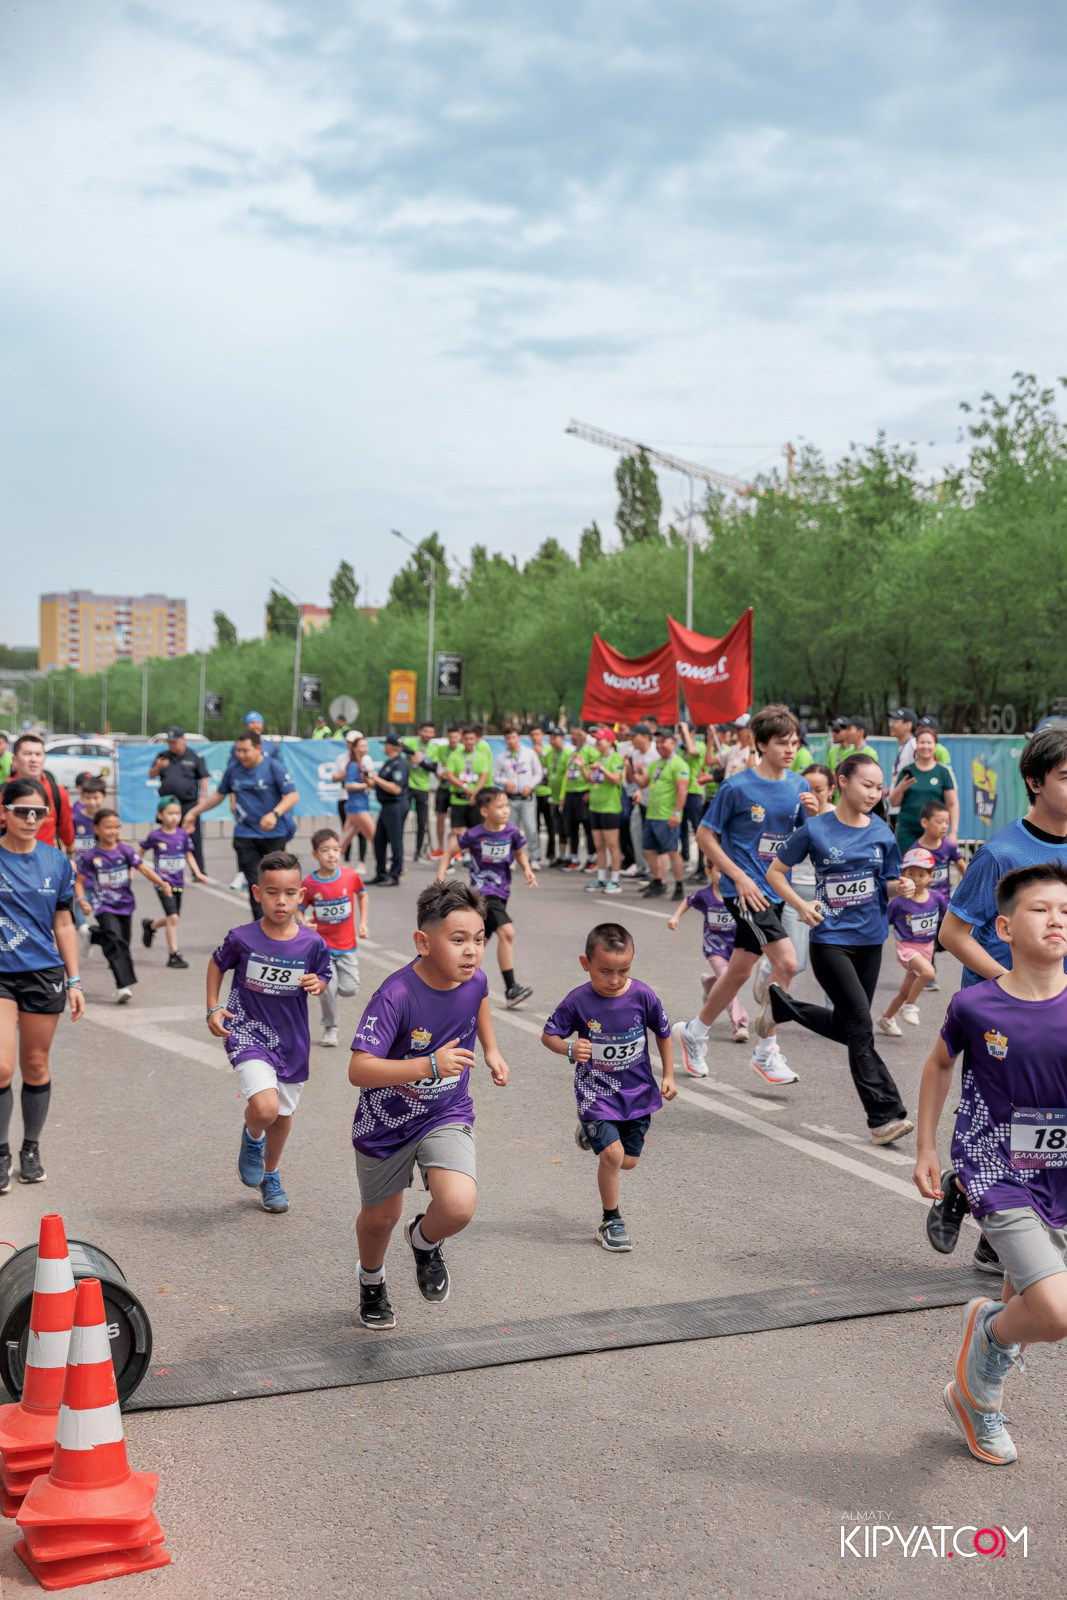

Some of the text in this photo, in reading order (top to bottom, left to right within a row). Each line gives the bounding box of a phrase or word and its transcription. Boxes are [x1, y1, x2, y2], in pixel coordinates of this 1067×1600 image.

[836, 880, 867, 896] 046
[322, 905, 346, 917] 205
[260, 966, 292, 983] 138
[603, 1041, 638, 1060] 033
[400, 1082, 431, 1095] АЛАЛАР
[1034, 1128, 1067, 1150] 18
[1013, 1152, 1058, 1160] БАЛАЛАР
[1045, 1160, 1063, 1168] 600
